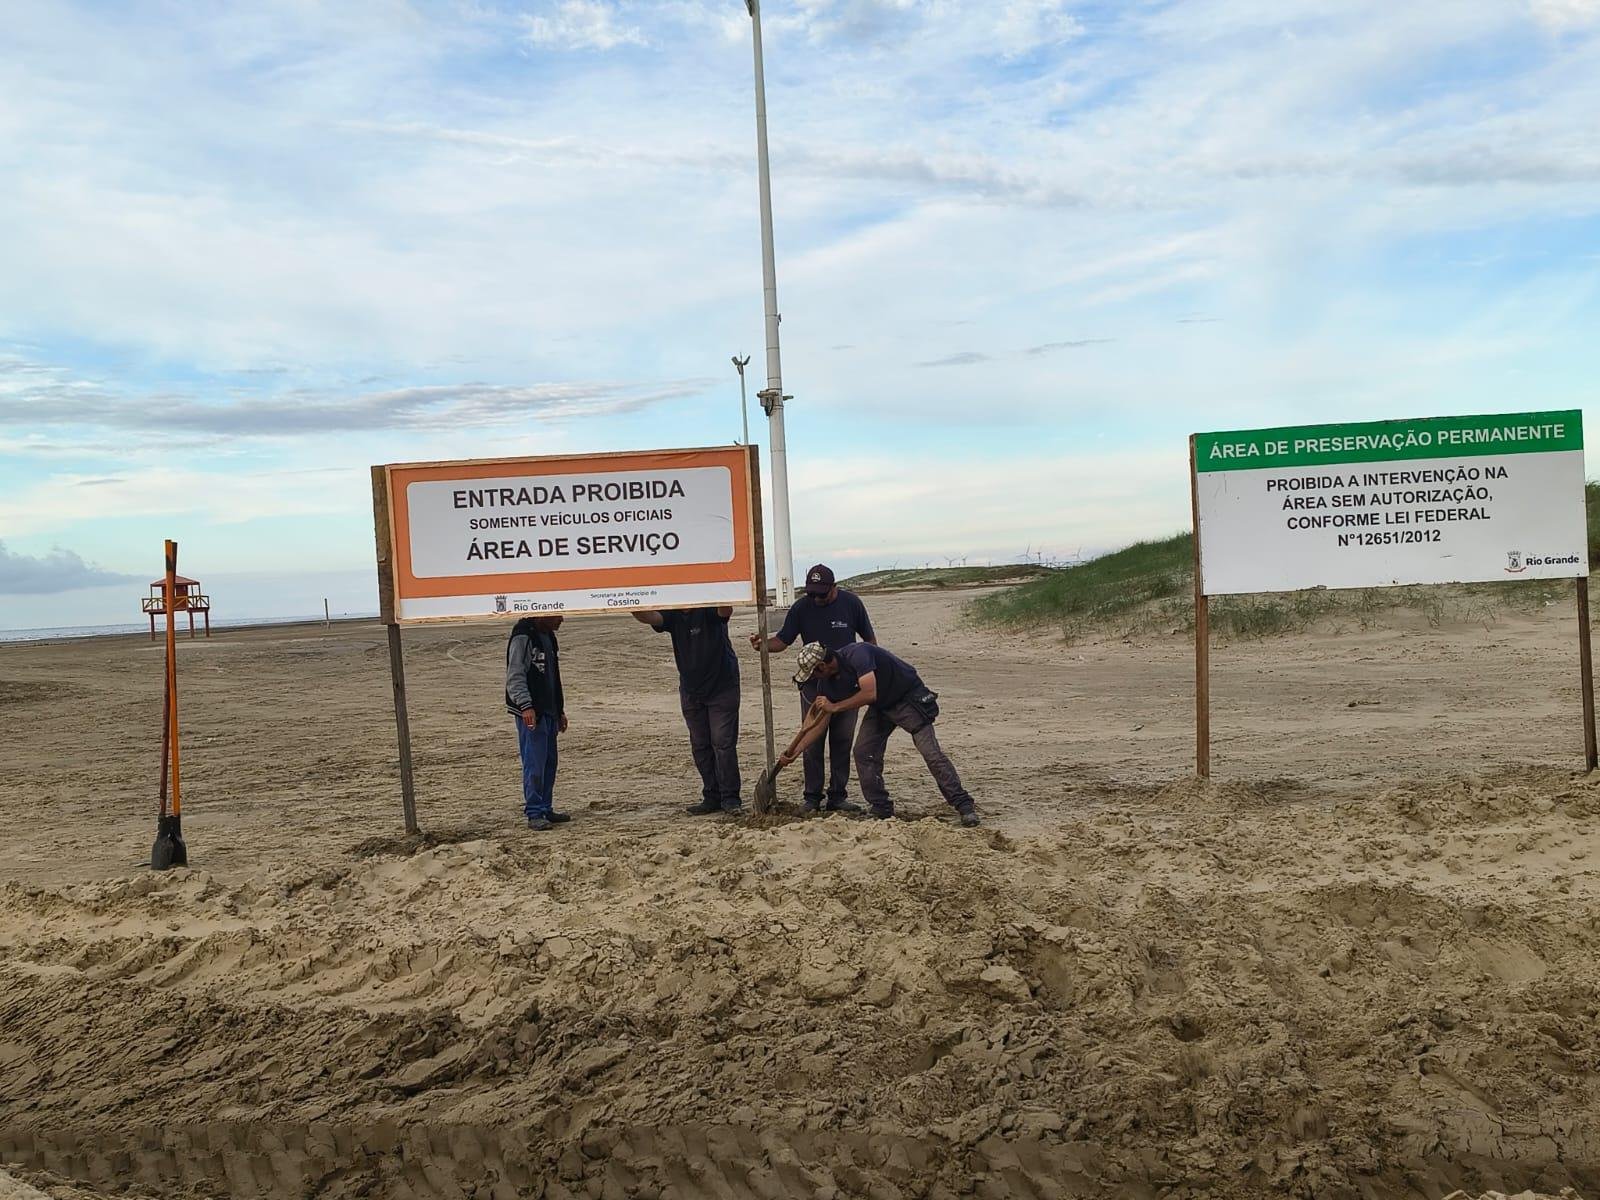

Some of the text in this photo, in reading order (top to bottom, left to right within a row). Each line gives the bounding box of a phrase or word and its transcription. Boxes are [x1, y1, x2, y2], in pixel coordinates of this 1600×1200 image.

[1210, 424, 1565, 460] ÁREA DE PRESERVAÇÃO PERMANENTE
[1266, 466, 1508, 492] PROIBIDA A INTERVENÇÃO NA
[453, 480, 685, 509] ENTRADA PROIBIDA
[1282, 484, 1493, 511] ÁREA SEM AUTORIZAÇÃO,
[470, 508, 673, 530] SOMENTE VEÍCULOS OFICIAIS
[1287, 506, 1491, 530] CONFORME LEI FEDERAL
[467, 532, 680, 560] ÁREA DE SERVIÇO
[1526, 555, 1580, 566] Rio Grande
[514, 601, 565, 612] Rio Grande
[607, 598, 640, 606] Cassino
